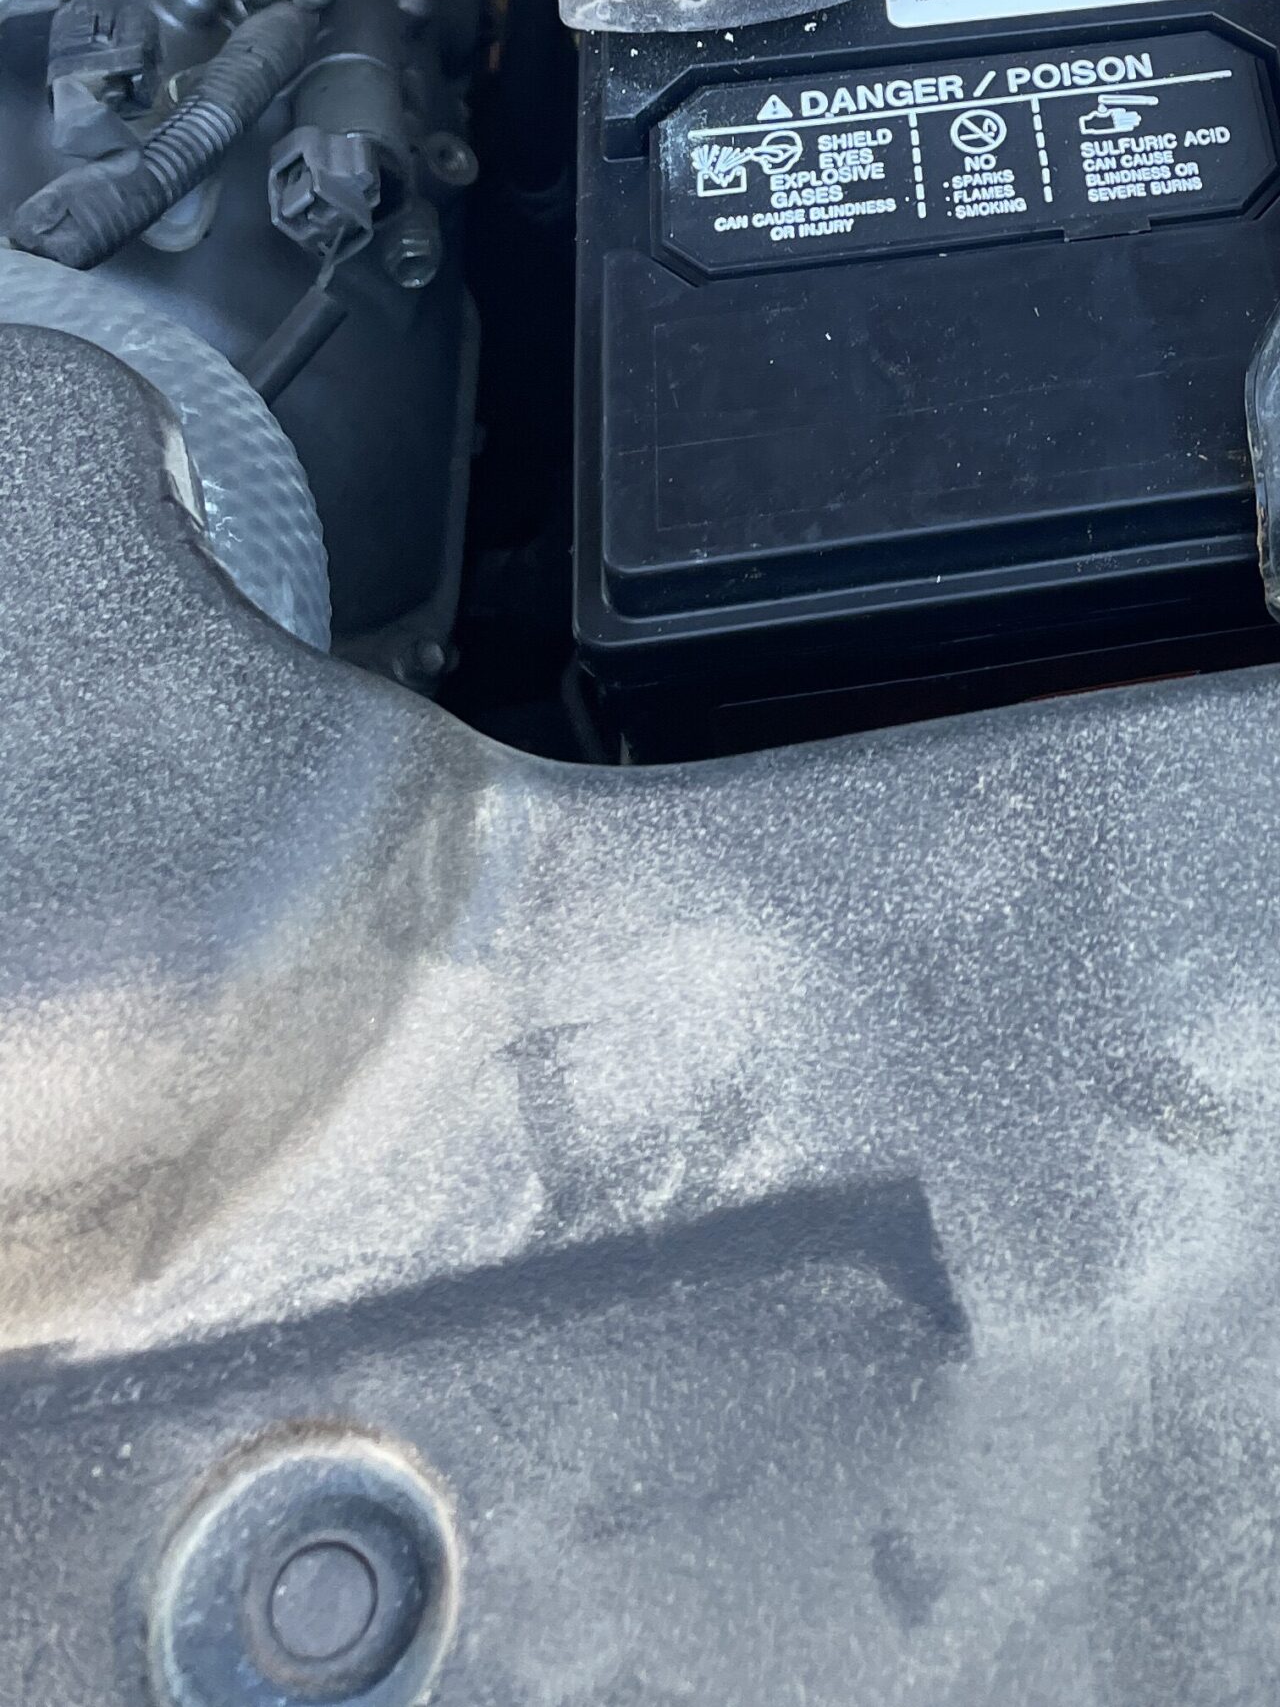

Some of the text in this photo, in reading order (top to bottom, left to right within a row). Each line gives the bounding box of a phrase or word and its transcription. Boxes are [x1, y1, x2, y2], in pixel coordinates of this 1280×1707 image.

[801, 52, 1154, 117] DANGER / POISON
[818, 128, 892, 151] SHIELD
[1080, 126, 1231, 158] SULFURIC ACID
[819, 147, 874, 170] EYES
[964, 153, 996, 172] NO
[1082, 150, 1174, 172] CAN CAUSE
[770, 162, 886, 191] EXPLOSIVE
[951, 169, 1015, 189] SPARKS
[1085, 162, 1199, 187] BLINDNESS OR
[771, 184, 844, 209] GASES
[953, 184, 1016, 204] FLAMES
[1087, 176, 1203, 202] SEVERE BURNS
[714, 198, 896, 232] CAN CAUSE BLINDNESS
[955, 197, 1028, 219] SMOKING
[770, 218, 854, 241] OR INJURY
